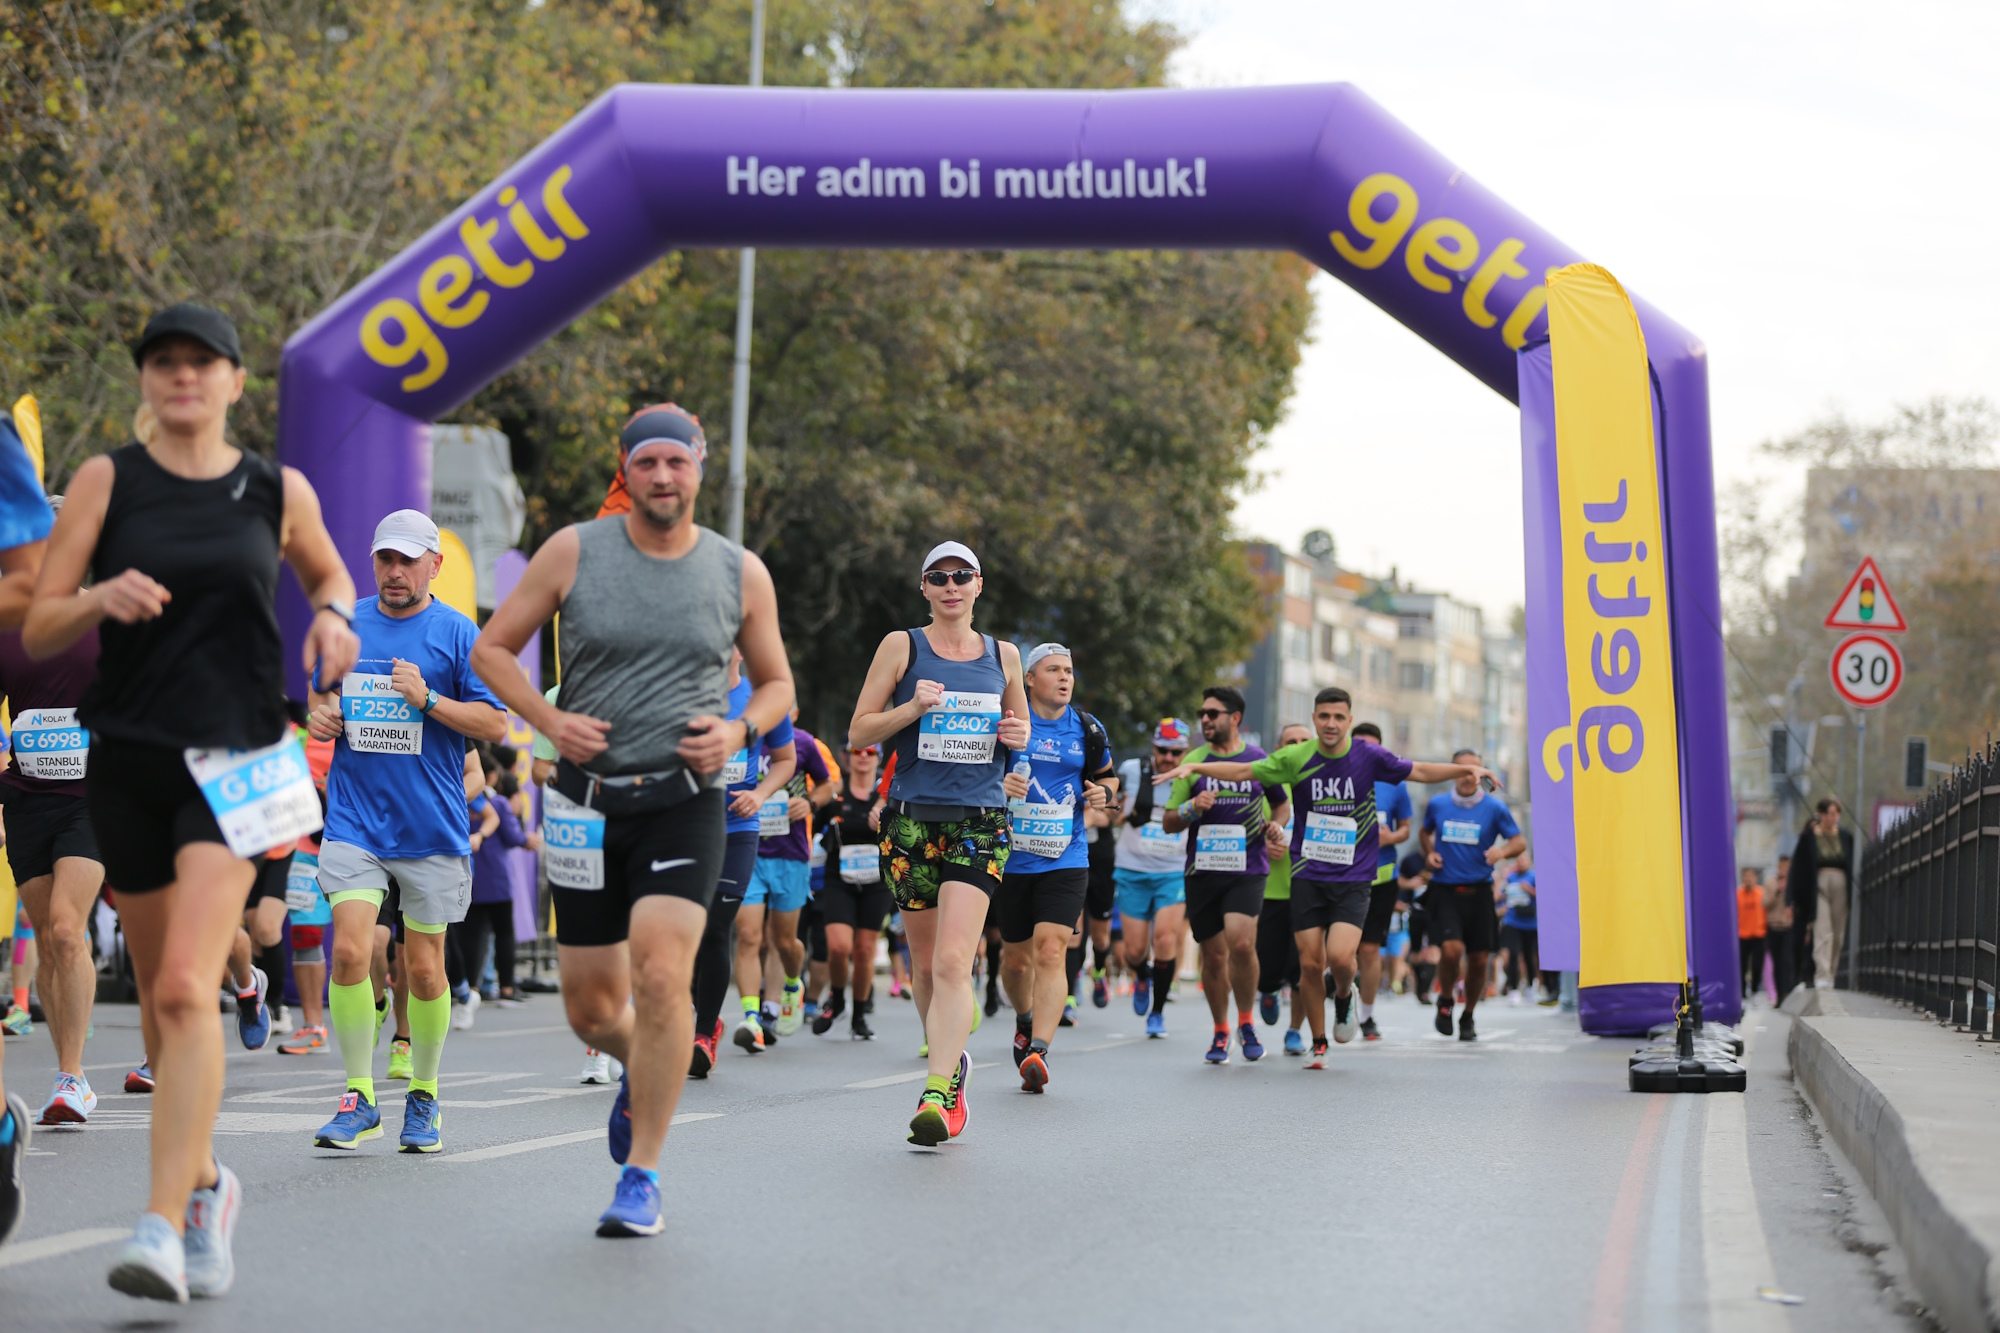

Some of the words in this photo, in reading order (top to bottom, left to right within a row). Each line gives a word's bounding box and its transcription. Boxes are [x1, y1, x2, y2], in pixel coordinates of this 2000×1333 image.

[726, 155, 806, 196] Her
[815, 157, 926, 198] adım
[939, 158, 981, 199] bi
[994, 157, 1207, 199] mutluluk!
[1328, 172, 1561, 353] geti
[358, 163, 591, 393] getir
[1846, 653, 1889, 686] 30
[374, 682, 395, 691] KOLA
[351, 698, 362, 716] F
[364, 701, 411, 721] 2526
[957, 699, 983, 707] KOLAY
[42, 715, 67, 723] KOLAY
[931, 713, 945, 729] F
[946, 715, 991, 733] 6402
[20, 732, 35, 749] G
[37, 731, 82, 749] 6998
[360, 726, 411, 741] ISTANBUL
[357, 739, 411, 752] MARATHON
[943, 739, 988, 751] ISTANBUL
[36, 756, 82, 767] ISTANBUL
[941, 751, 987, 761] MARATHON
[37, 768, 83, 777] MARATHON
[220, 773, 249, 803] G
[1021, 819, 1031, 832] F
[1032, 821, 1065, 835] 2735
[1029, 838, 1065, 849] ISTANBUL
[1312, 829, 1322, 840] F
[1322, 830, 1347, 844] 2611
[1202, 839, 1211, 850] F
[1211, 839, 1239, 852] 2610
